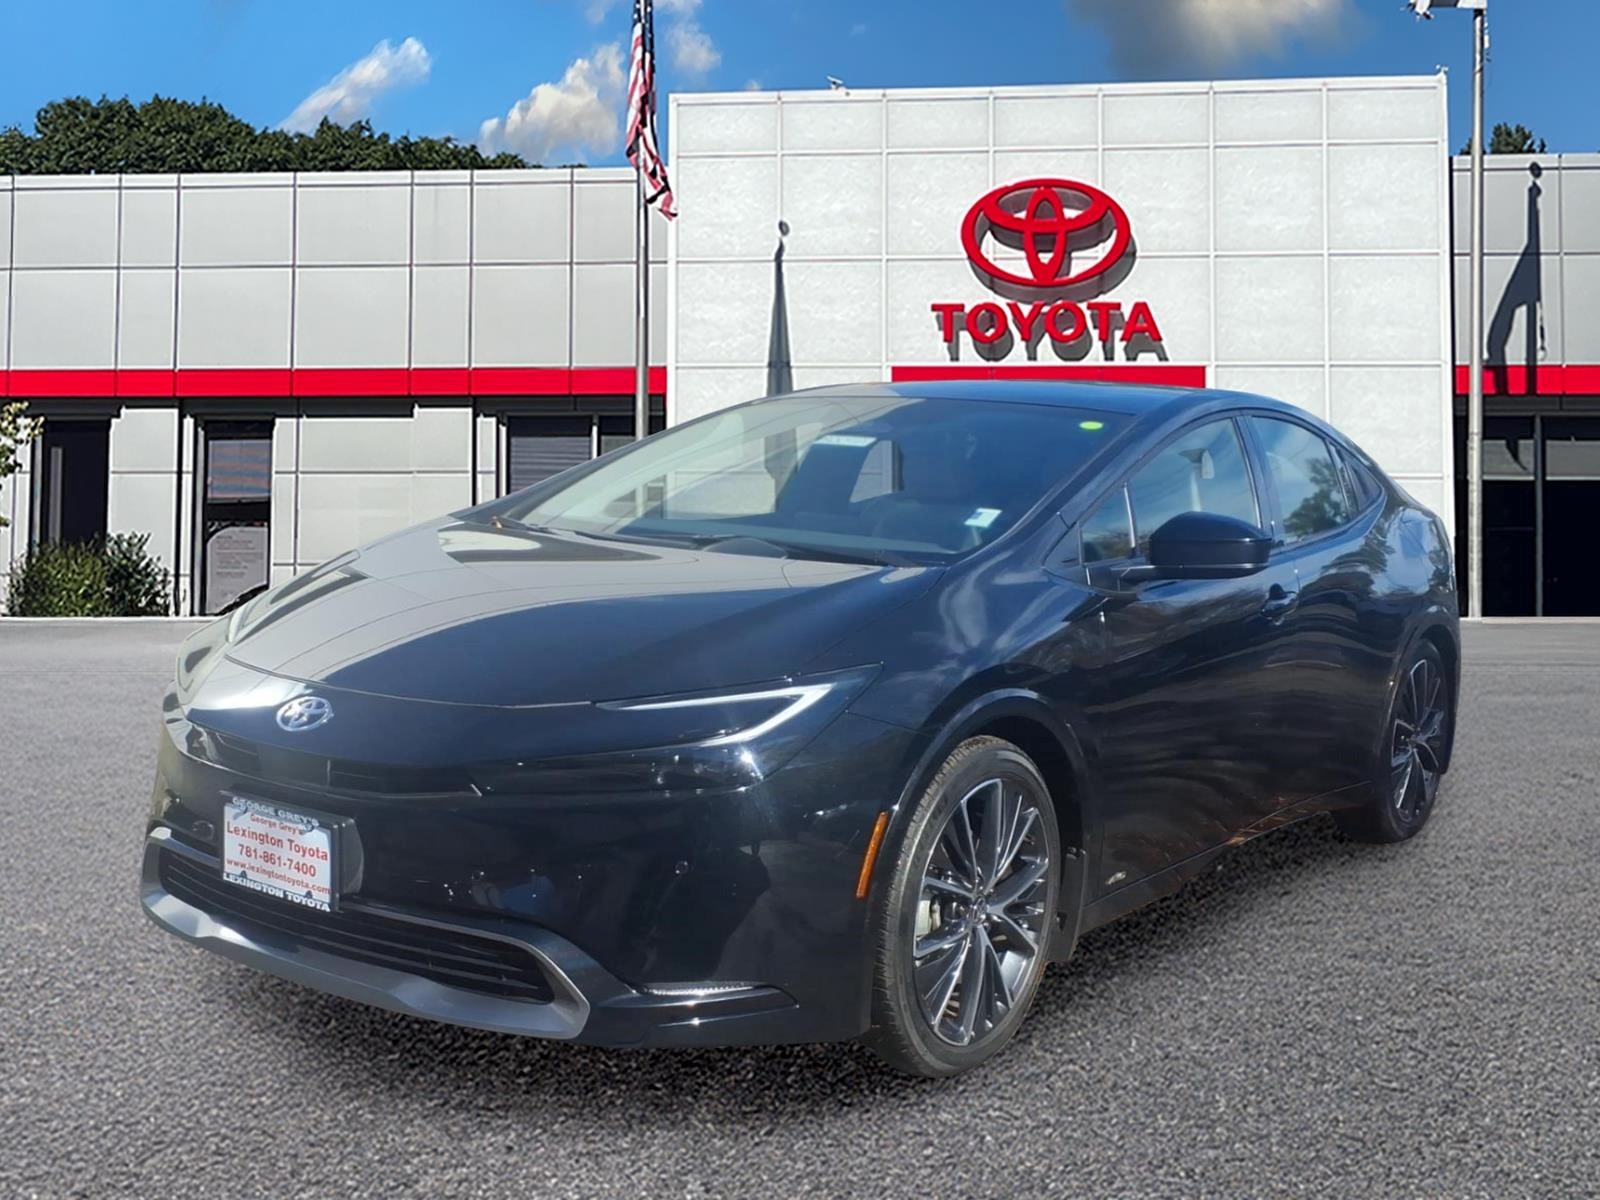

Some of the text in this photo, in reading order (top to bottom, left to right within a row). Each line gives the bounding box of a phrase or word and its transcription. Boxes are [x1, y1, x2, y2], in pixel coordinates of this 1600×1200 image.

[931, 301, 1163, 344] TOYOTA
[232, 797, 275, 815] GEORGE
[250, 813, 278, 829] George
[226, 821, 328, 861] Lexington Toyota
[226, 858, 331, 895] www.lexingtontoyota.com
[238, 843, 317, 877] 781-861-7400
[223, 872, 331, 912] LEXINGTON TOYOTA
